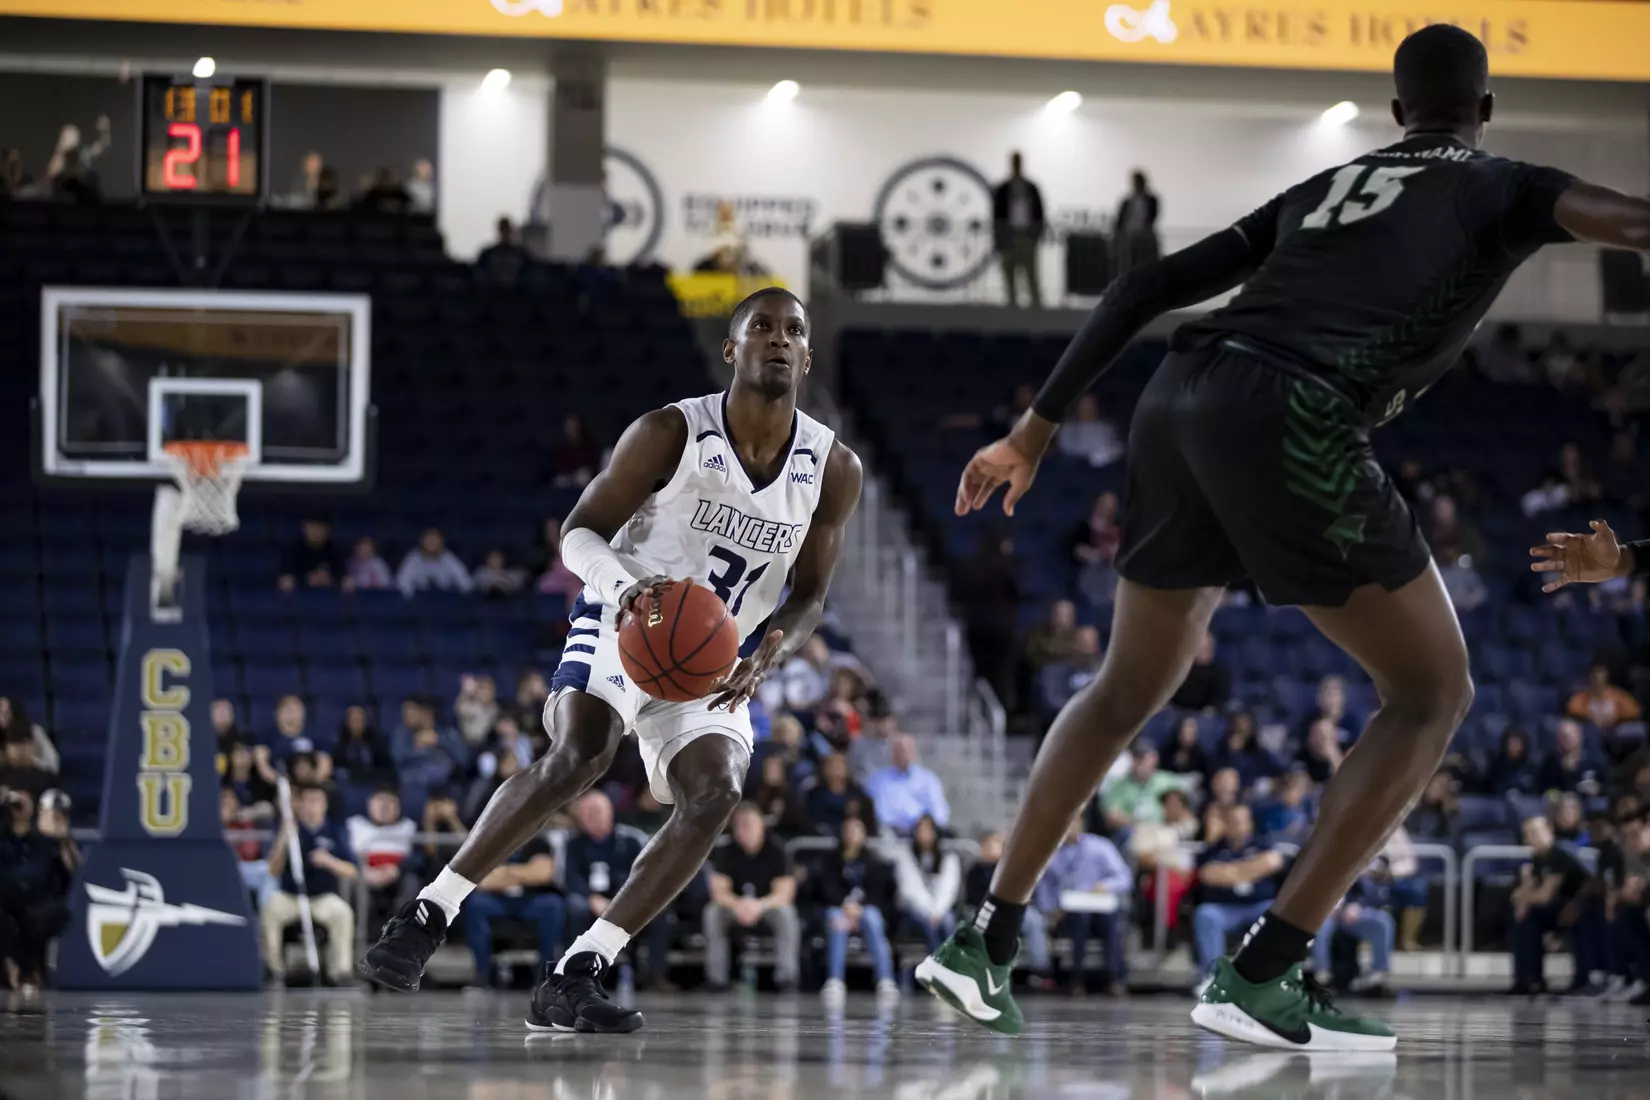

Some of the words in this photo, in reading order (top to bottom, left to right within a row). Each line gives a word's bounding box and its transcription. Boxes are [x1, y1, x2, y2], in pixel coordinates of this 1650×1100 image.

[1182, 8, 1330, 47] AYRES
[1348, 11, 1531, 55] HOLS
[163, 122, 240, 189] 21
[1300, 164, 1427, 231] 15
[703, 460, 726, 473] adidas
[791, 472, 814, 486] WAC
[690, 498, 803, 554] LANCERS
[708, 545, 771, 617] 31
[137, 648, 192, 837] CBU
